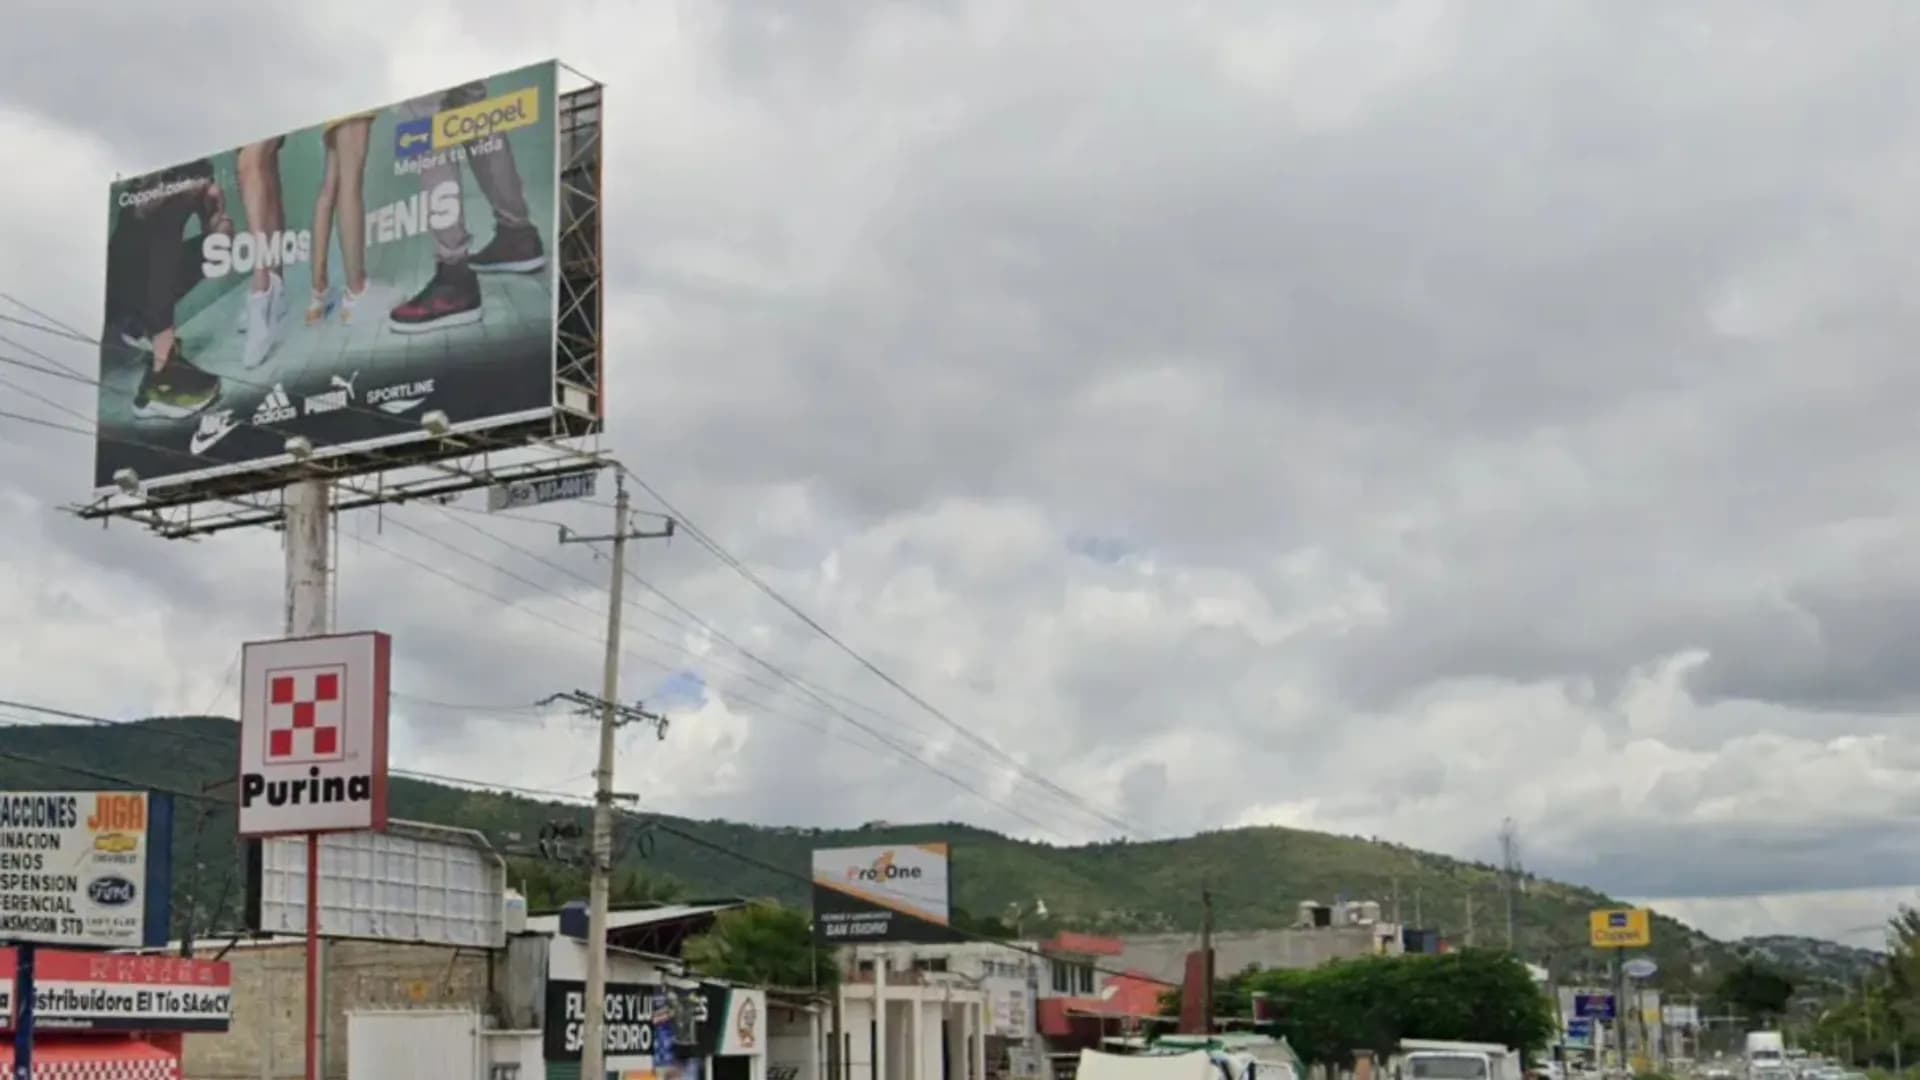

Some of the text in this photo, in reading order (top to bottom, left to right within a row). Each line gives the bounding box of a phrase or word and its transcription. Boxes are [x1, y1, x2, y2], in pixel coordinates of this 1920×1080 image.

[443, 98, 526, 138] Coppel
[395, 137, 503, 176] Mejora tu vida
[202, 181, 460, 278] SOMOS TENIS
[367, 379, 435, 404] SPORTLINE
[253, 406, 297, 426] adidas
[241, 765, 371, 808] Purina
[0, 796, 77, 829] ACCIONES
[1, 832, 60, 849] INACION
[1, 854, 43, 870] ENOS
[885, 865, 922, 878] One
[1, 874, 77, 892] SPENSION
[0, 894, 75, 913] ERENCIAL
[0, 916, 57, 934] NSMISION
[33, 987, 132, 1012] istribuidora
[137, 990, 152, 1011] El
[566, 992, 623, 1020] FILOS
[625, 995, 636, 1020] Y
